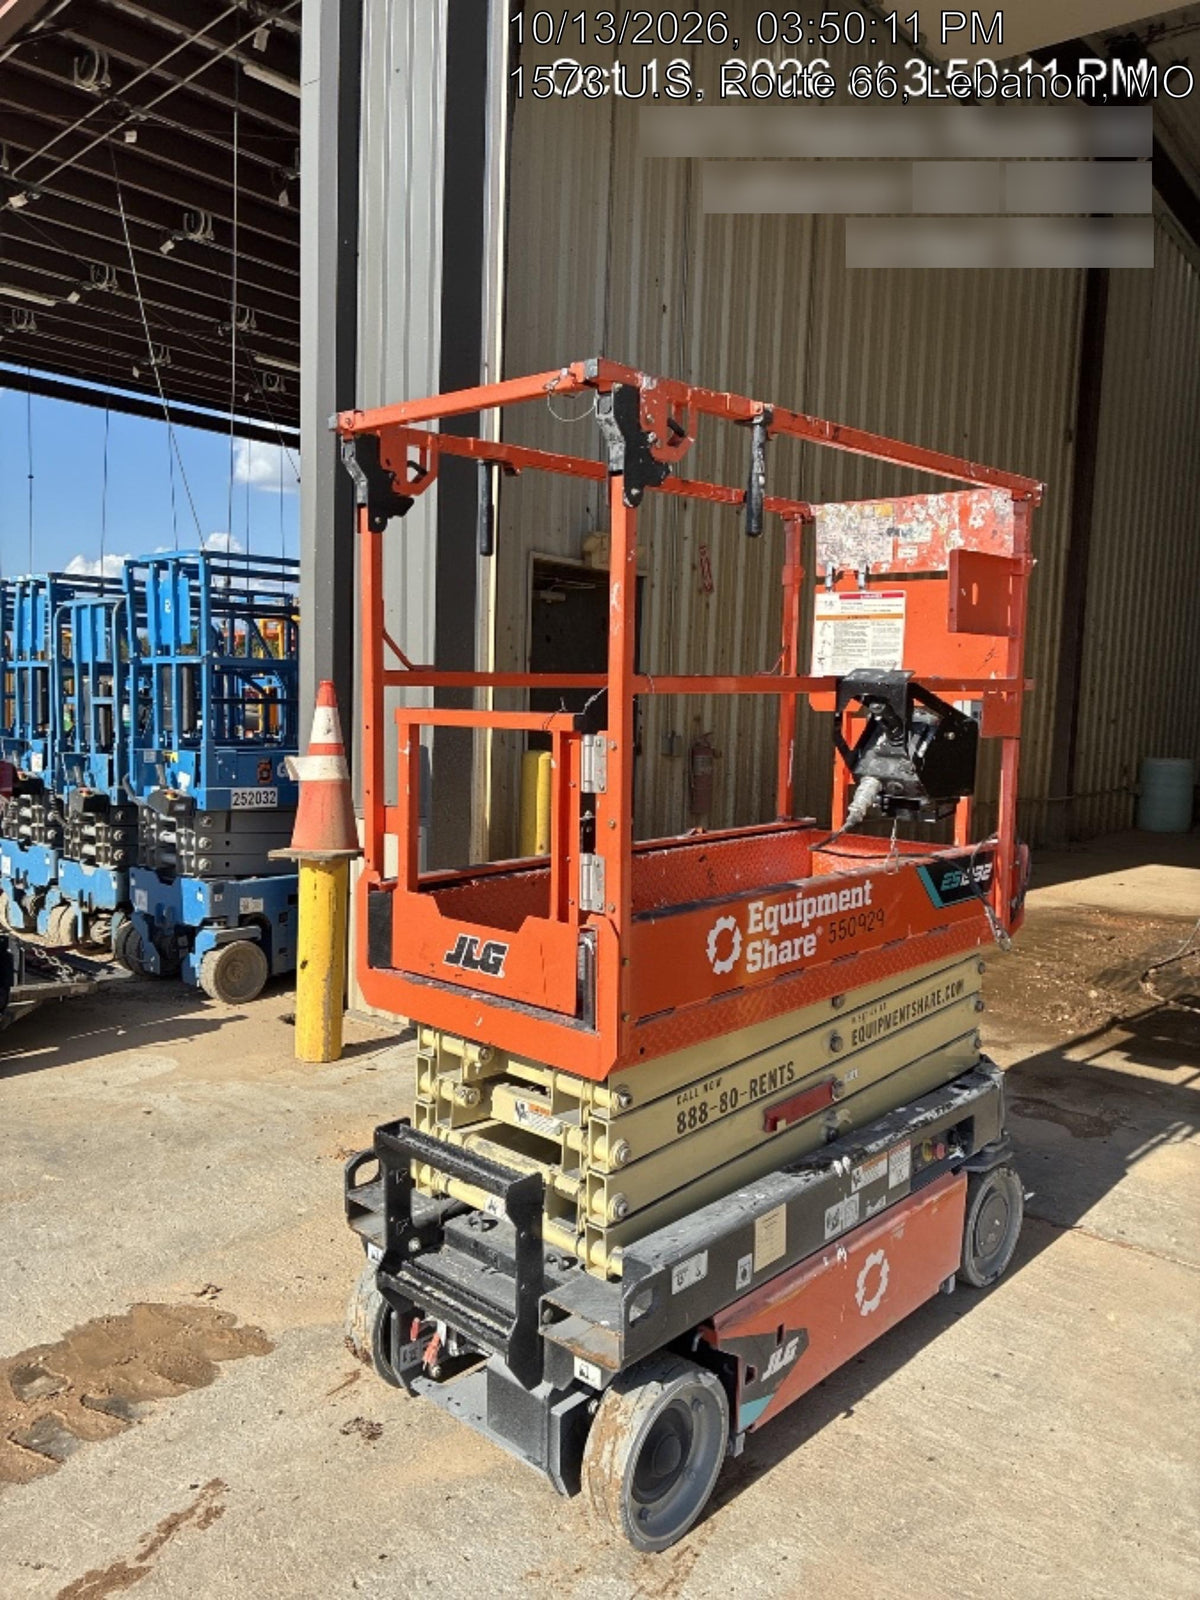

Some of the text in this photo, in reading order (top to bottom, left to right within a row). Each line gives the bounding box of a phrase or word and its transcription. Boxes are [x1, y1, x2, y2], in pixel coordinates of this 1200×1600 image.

[232, 790, 277, 806] 252032
[747, 879, 873, 936] Equipment
[828, 907, 886, 945] 550929
[443, 933, 509, 977] JLG
[851, 978, 965, 1047] EQUIPMENTSHARE.COM
[676, 1061, 795, 1135] 888-80-RENTS
